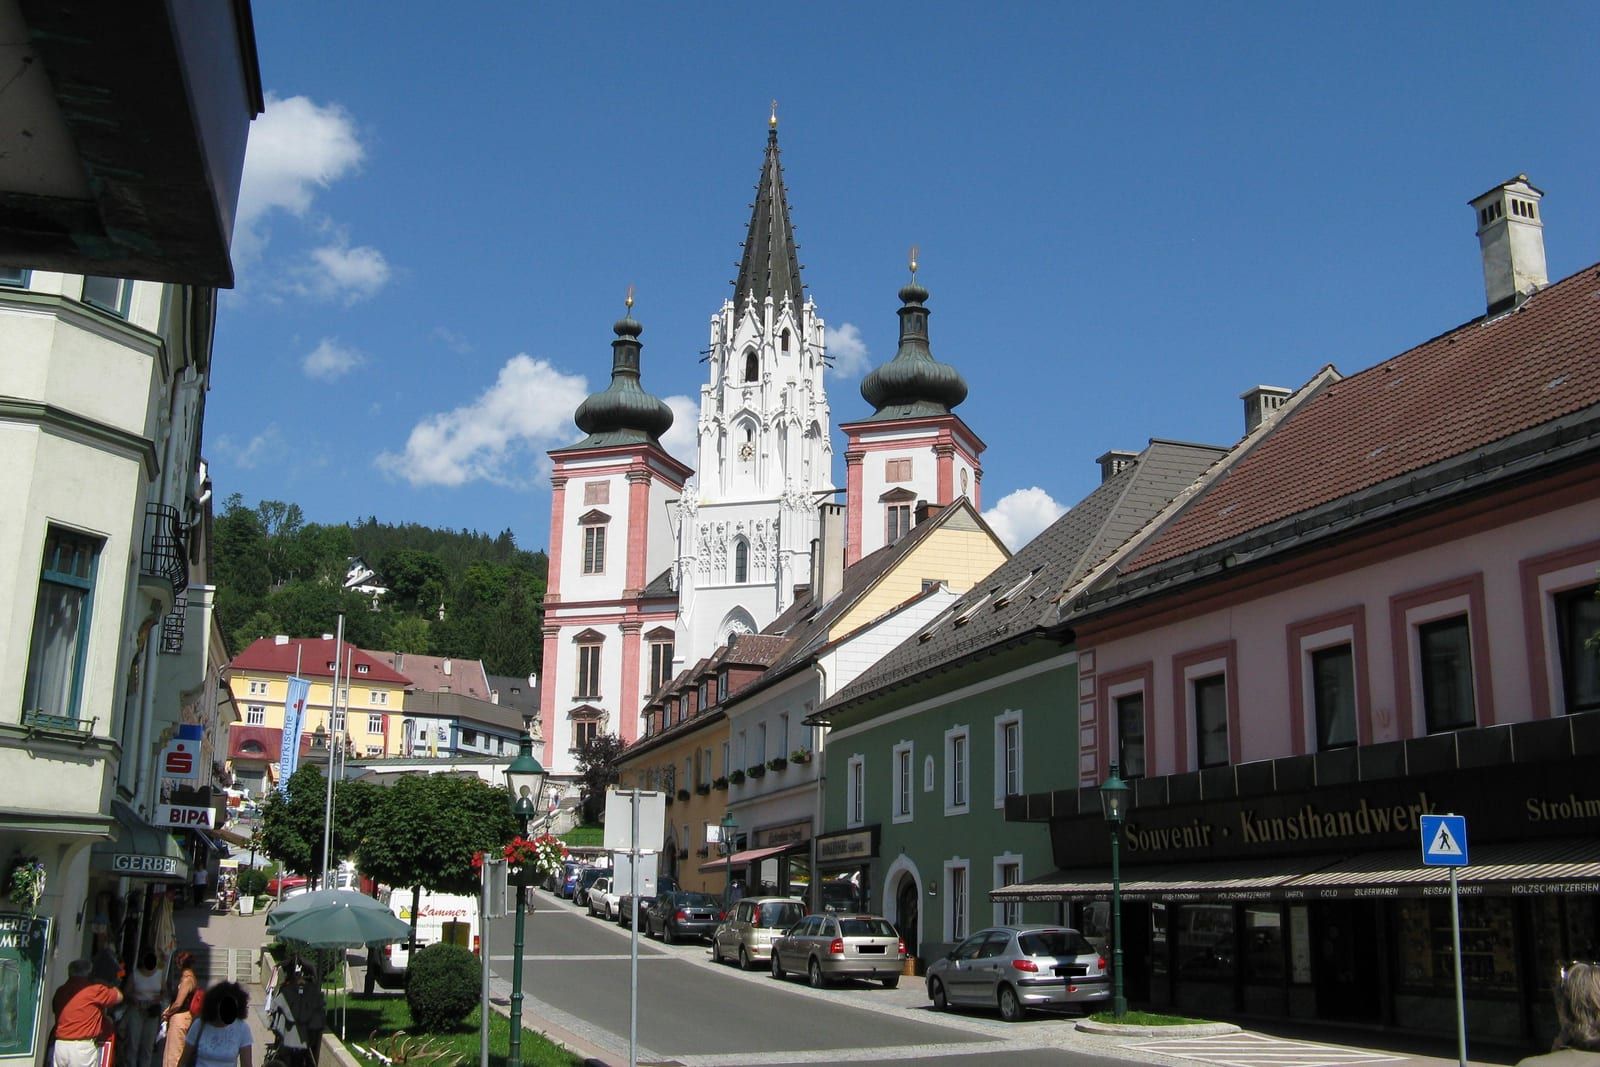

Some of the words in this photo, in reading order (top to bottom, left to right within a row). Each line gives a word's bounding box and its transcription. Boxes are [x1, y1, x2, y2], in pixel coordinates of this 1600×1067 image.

[1526, 793, 1600, 821] Strohm
[169, 808, 210, 825] BIPA
[1124, 819, 1211, 852] Souvenir
[116, 855, 177, 872] GERBER
[1354, 888, 1399, 897] SILBERWAREN
[1423, 885, 1483, 895] REISEANENKEN
[1511, 883, 1599, 894] HOLZSCHNITZEREIEN
[416, 904, 469, 918] Lammer
